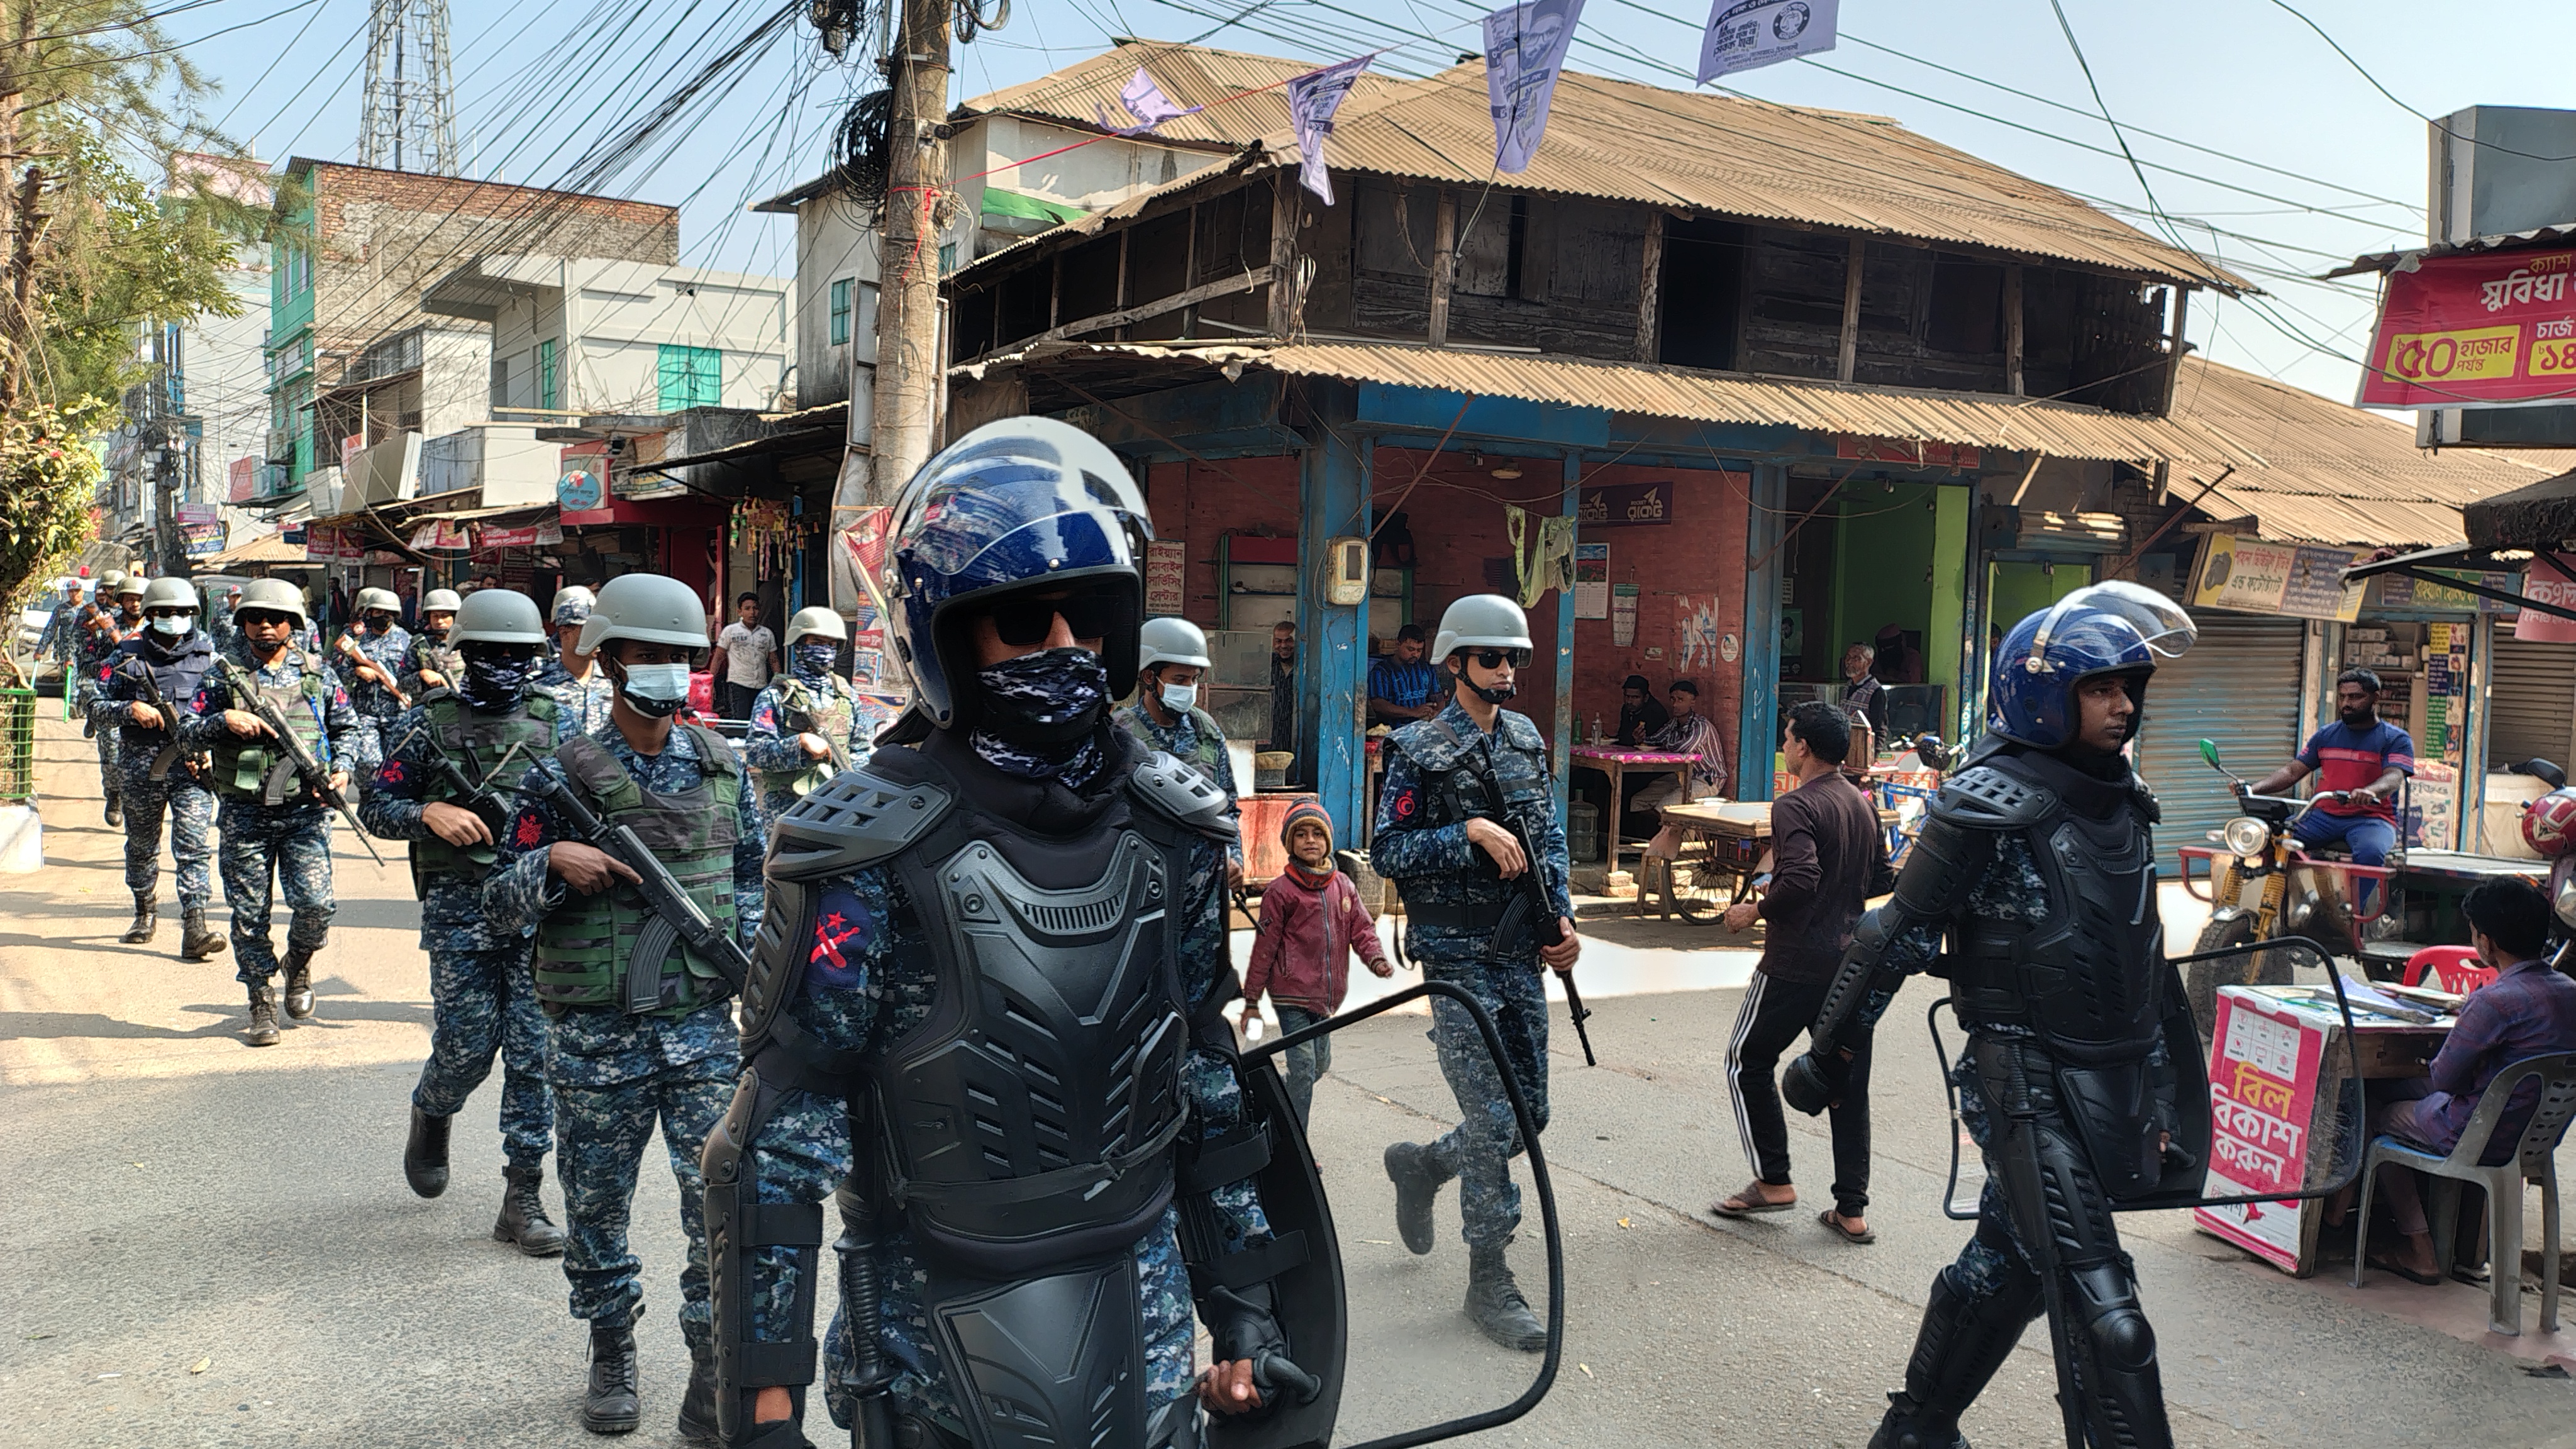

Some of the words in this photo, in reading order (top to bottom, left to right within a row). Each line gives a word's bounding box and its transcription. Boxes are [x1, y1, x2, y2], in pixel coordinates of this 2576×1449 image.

[2530, 253, 2572, 273] ক্যাশ
[2480, 269, 2568, 312] সুবিধা
[2536, 315, 2574, 338] চার্জ
[2460, 336, 2514, 357] হাজার
[2456, 357, 2486, 372] পর্যন্ত
[1148, 560, 1183, 574] মোবাইল
[2233, 1061, 2294, 1119] বিল
[2210, 1082, 2302, 1158] বিকাশ
[2214, 1130, 2285, 1184] করুন
